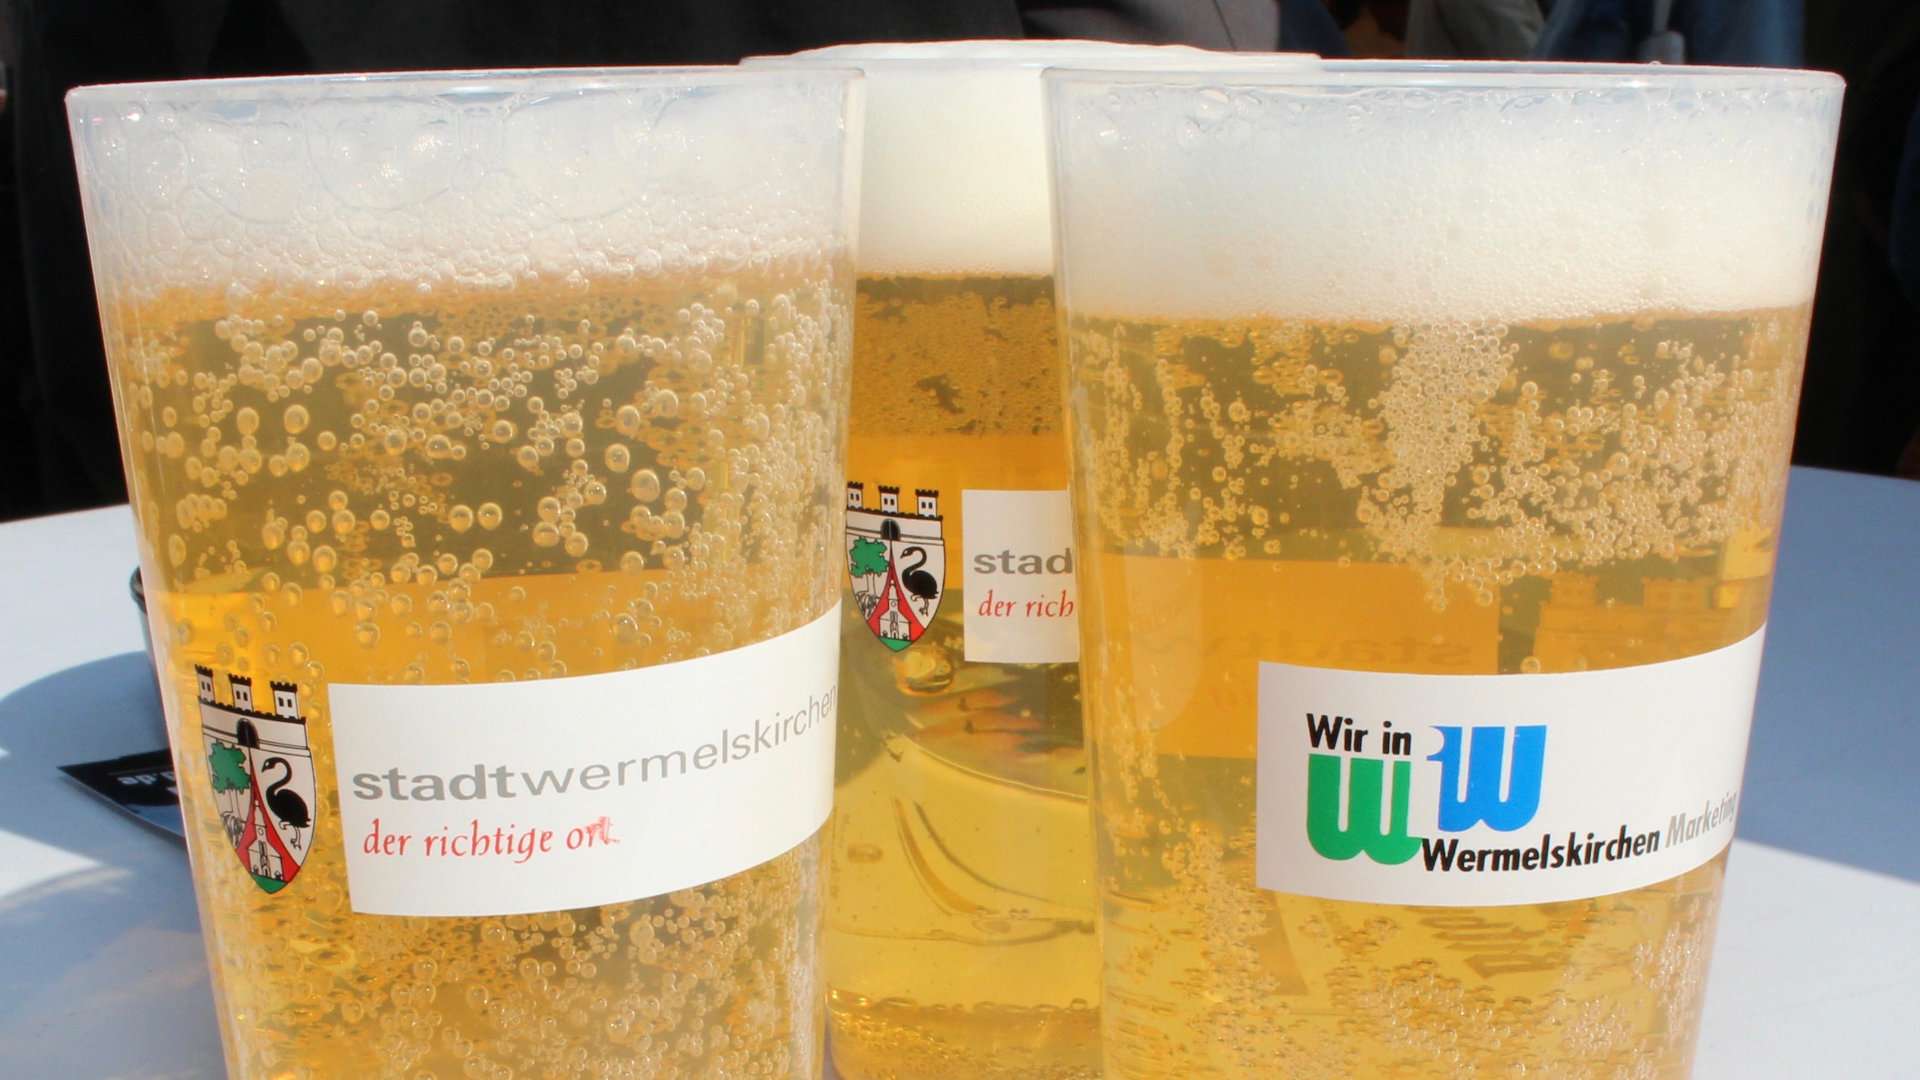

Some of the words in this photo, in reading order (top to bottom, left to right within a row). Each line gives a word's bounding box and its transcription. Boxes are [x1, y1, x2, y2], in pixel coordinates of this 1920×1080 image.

[973, 546, 1073, 576] stad
[978, 588, 1016, 617] der
[1026, 588, 1075, 618] rich
[351, 683, 837, 802] stadtwermelskirchen
[1306, 713, 1368, 754] Wir
[1382, 720, 1412, 756] in
[363, 817, 412, 857] der
[423, 818, 553, 865] richtige
[565, 815, 620, 851] ort
[1421, 824, 1661, 873] Wermelskirchen
